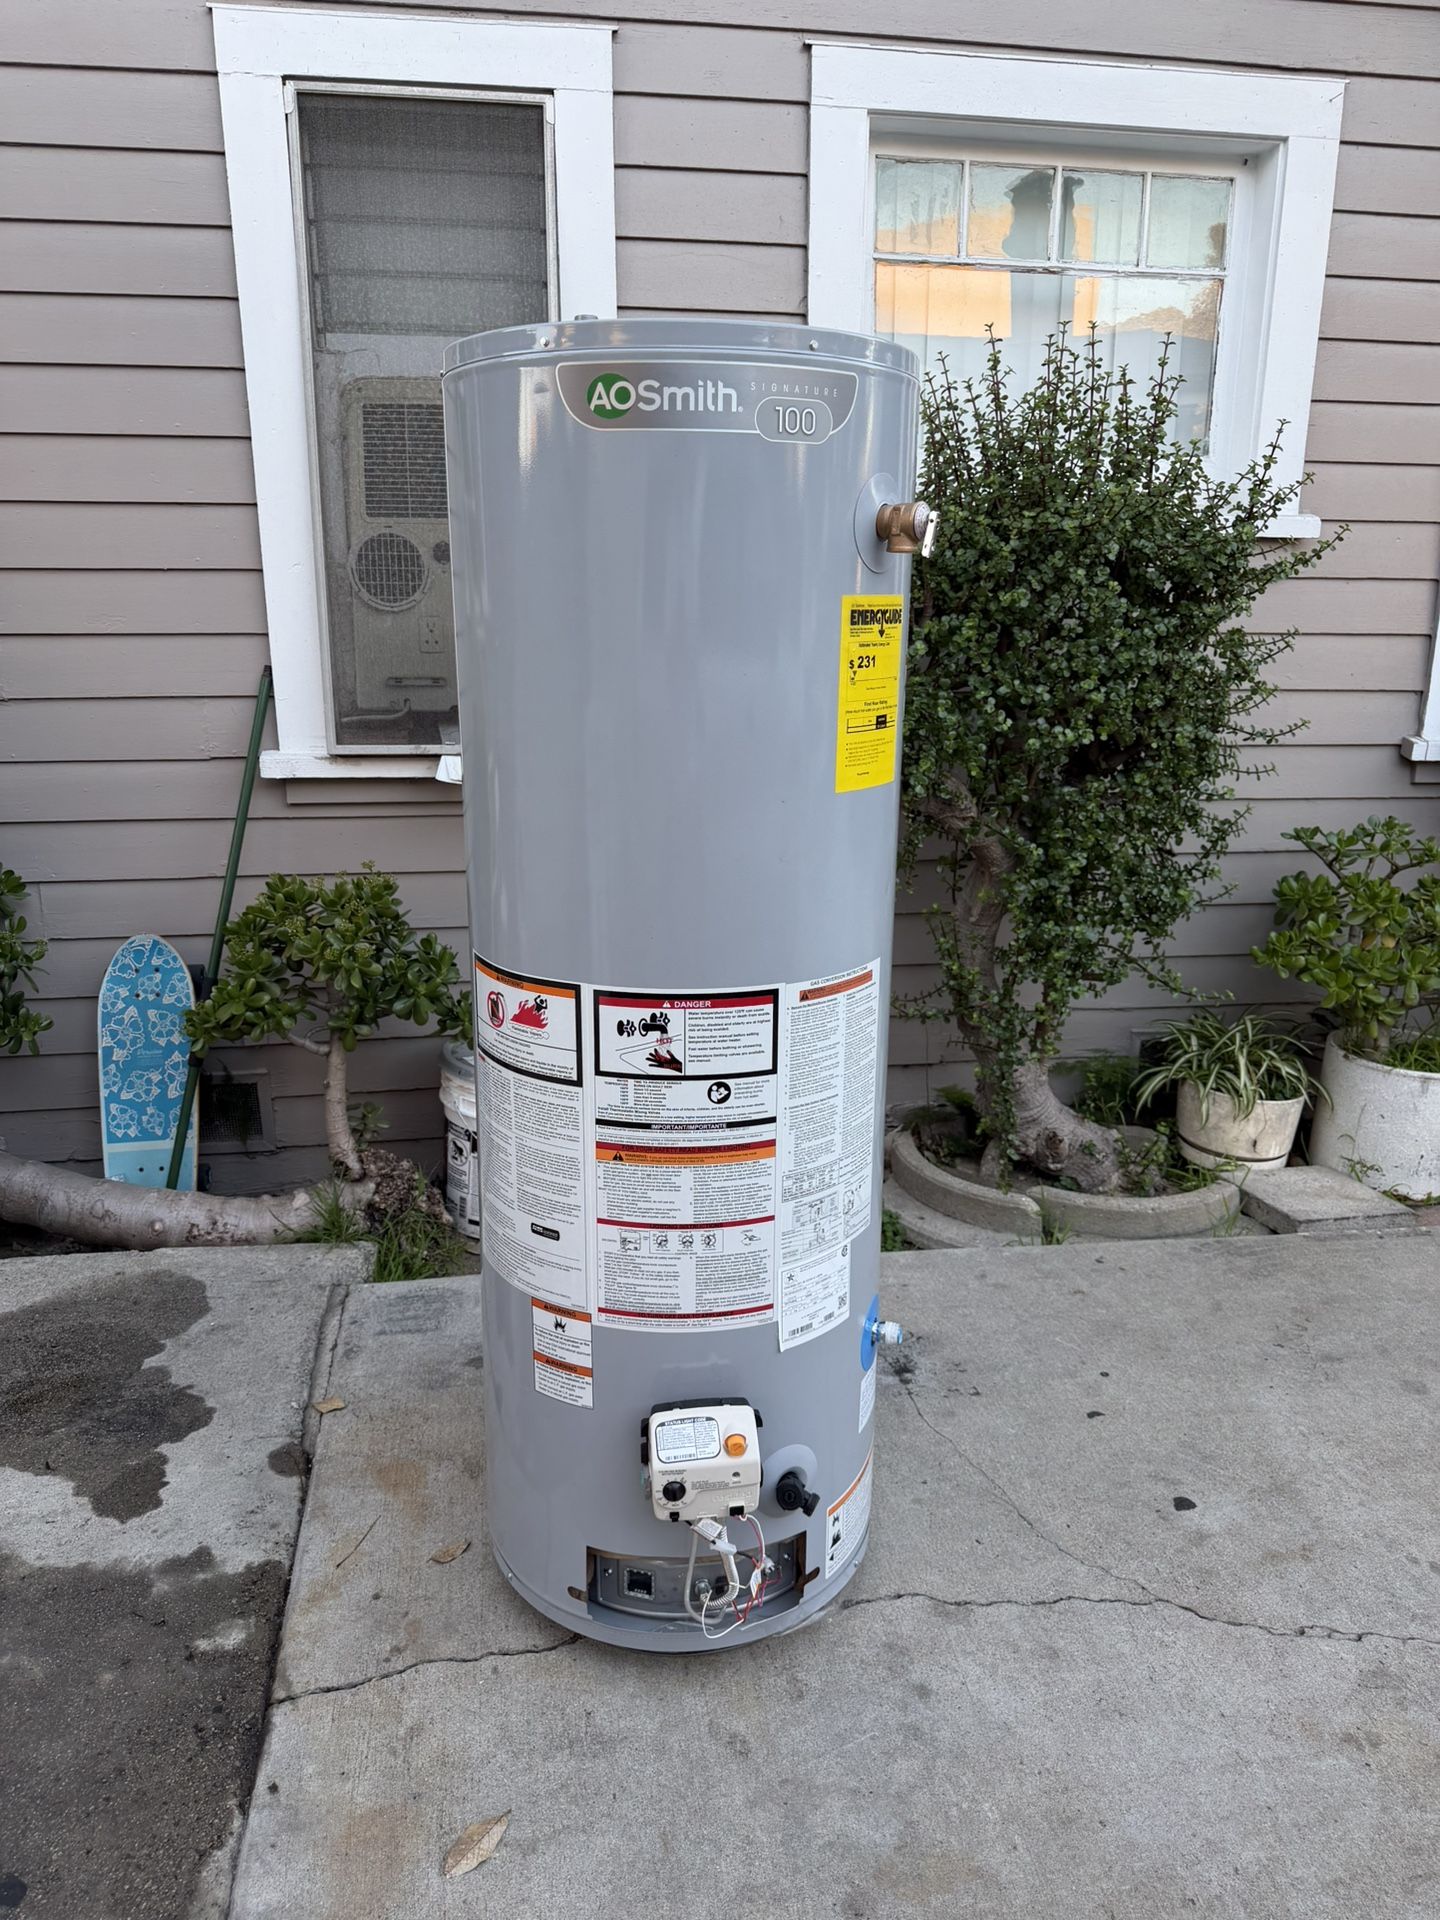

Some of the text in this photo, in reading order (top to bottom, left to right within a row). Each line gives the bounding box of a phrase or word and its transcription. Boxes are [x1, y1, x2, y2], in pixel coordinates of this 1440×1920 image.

[750, 381, 839, 398] SIGNATURE
[774, 405, 817, 435] 100
[849, 655, 876, 669] $ 231
[548, 1305, 577, 1318] WARNING
[550, 1360, 578, 1373] WARNING
